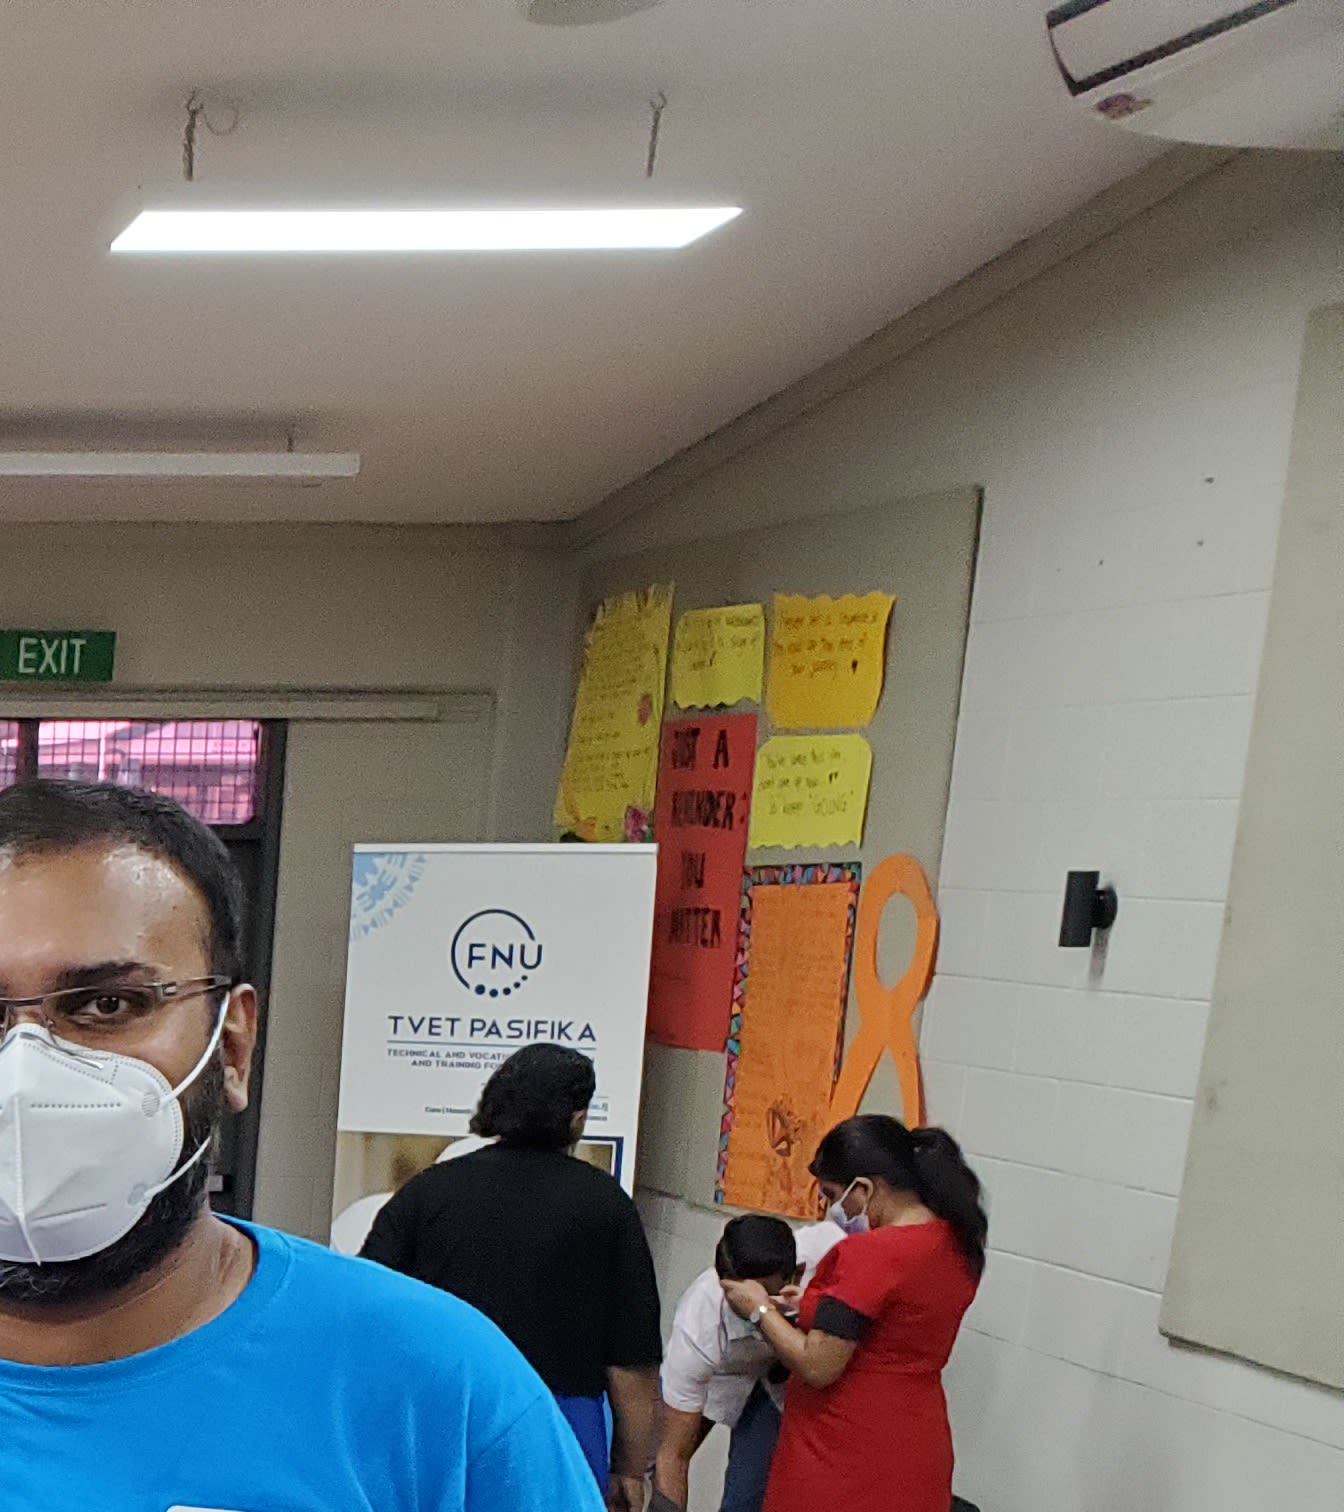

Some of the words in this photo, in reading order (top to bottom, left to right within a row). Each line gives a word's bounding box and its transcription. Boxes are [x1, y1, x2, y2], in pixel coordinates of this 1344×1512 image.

[18, 637, 87, 674] EXIT
[713, 729, 729, 769] A
[467, 943, 543, 970] FNU
[388, 1015, 461, 1037] TVET
[470, 1018, 597, 1042] PASIFIKA
[387, 1048, 441, 1058] TECHNICAL
[445, 1050, 466, 1059] AND
[411, 1059, 432, 1068] AND
[435, 1060, 482, 1069] TRAINING
